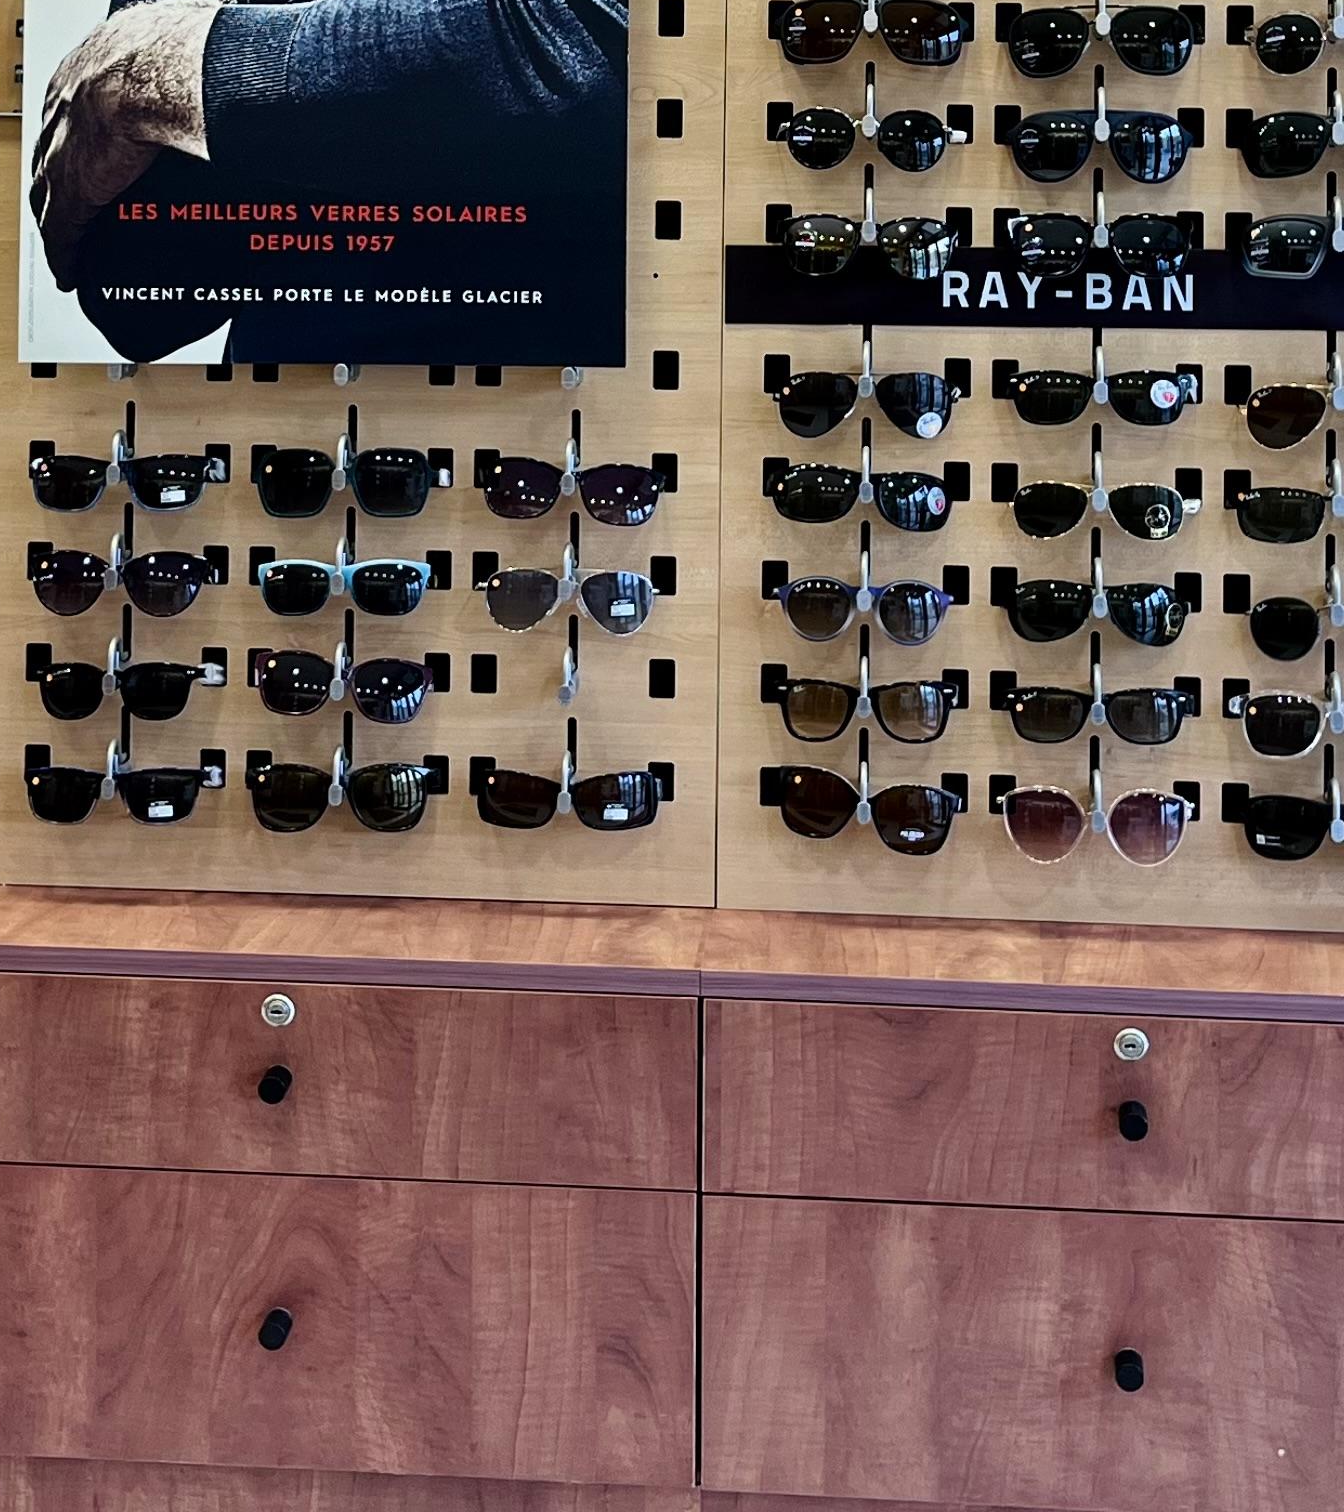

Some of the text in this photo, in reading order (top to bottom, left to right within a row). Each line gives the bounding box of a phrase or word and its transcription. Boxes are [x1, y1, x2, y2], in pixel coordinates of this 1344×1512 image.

[118, 203, 527, 223] LES MEILLEURS VERRES SOLAIRES
[249, 234, 395, 252] DEPUIS 1957
[102, 285, 544, 304] VINCENT CASSEL PORTE LE MODÈLE GLACIER
[942, 270, 1194, 312] RAY-BAN
